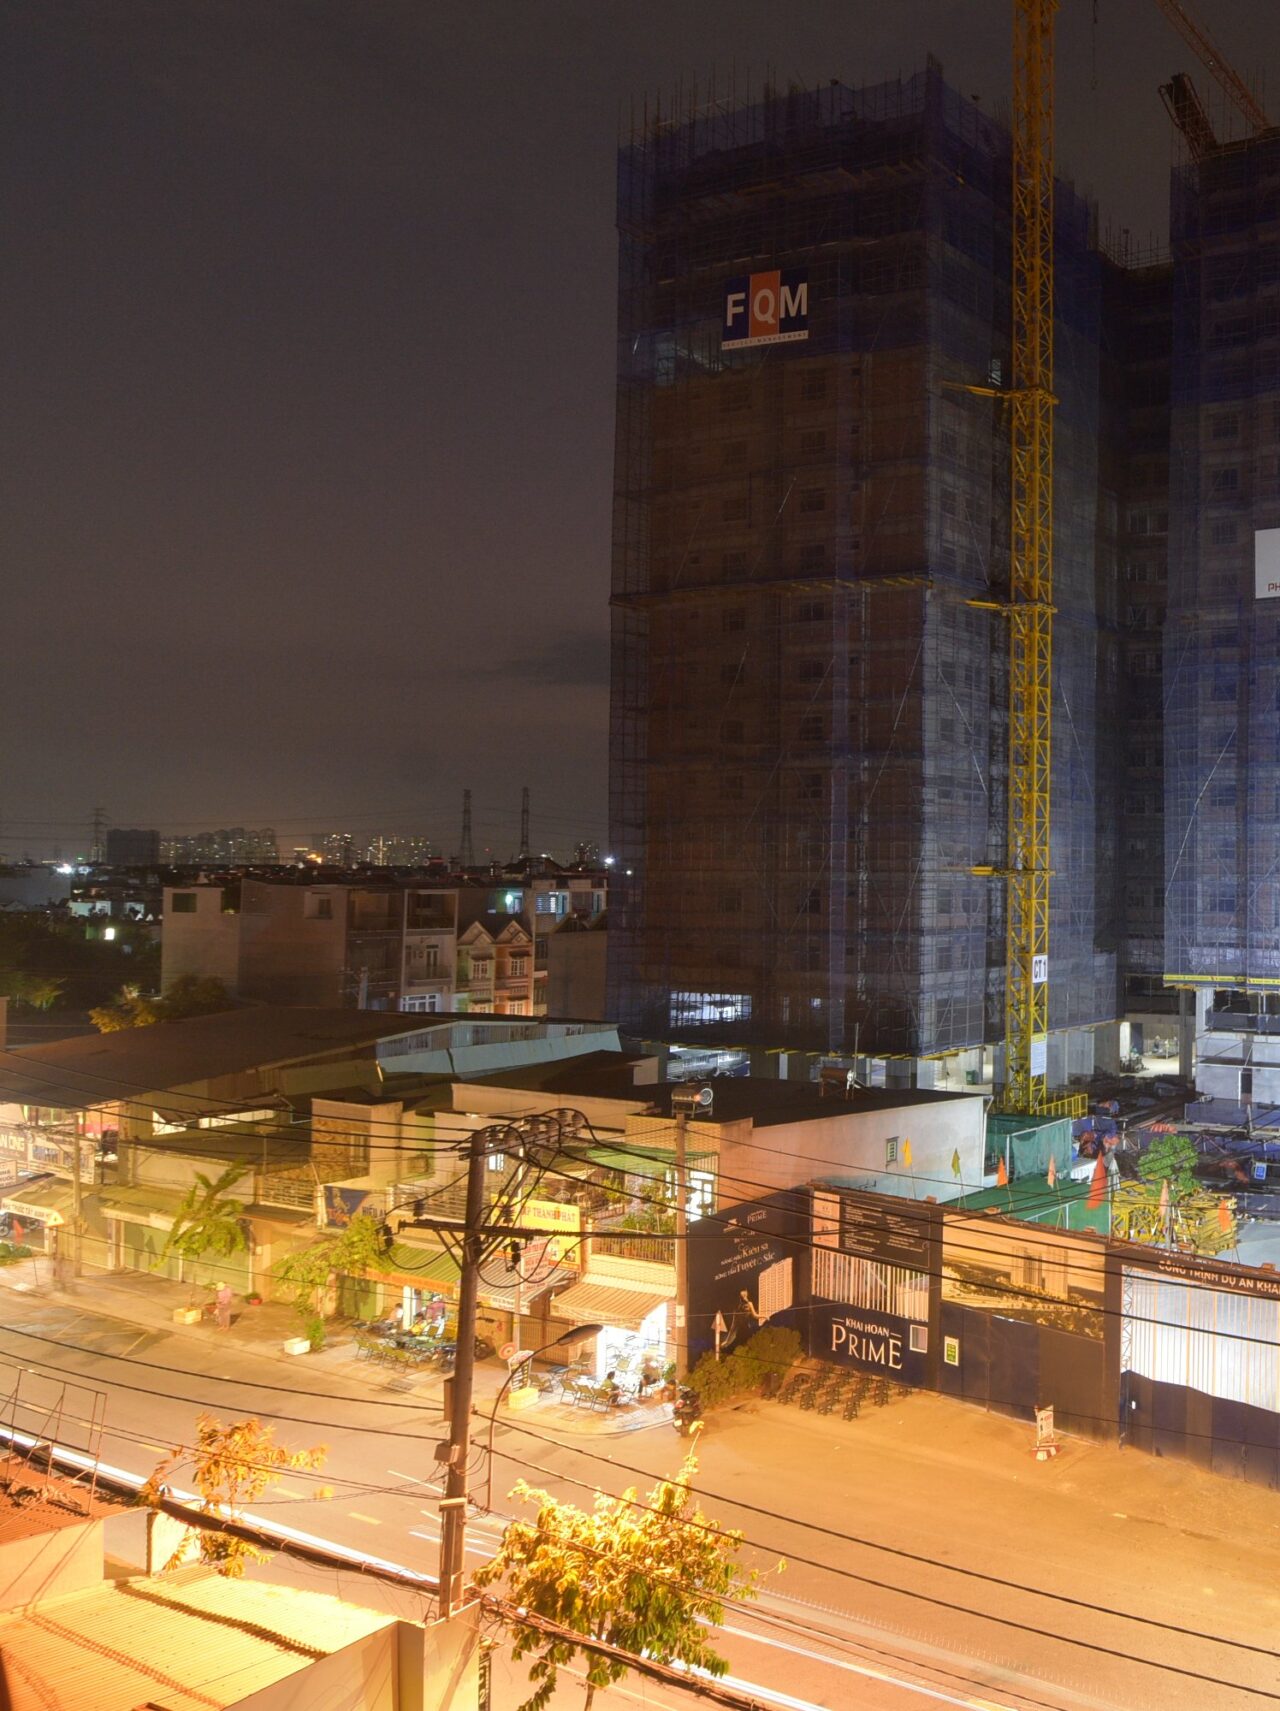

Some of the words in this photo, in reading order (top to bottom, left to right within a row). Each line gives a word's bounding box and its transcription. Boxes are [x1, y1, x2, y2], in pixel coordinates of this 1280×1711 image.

[726, 282, 808, 327] FQM
[831, 1323, 903, 1370] PRIME
[845, 1317, 864, 1331] KHAI
